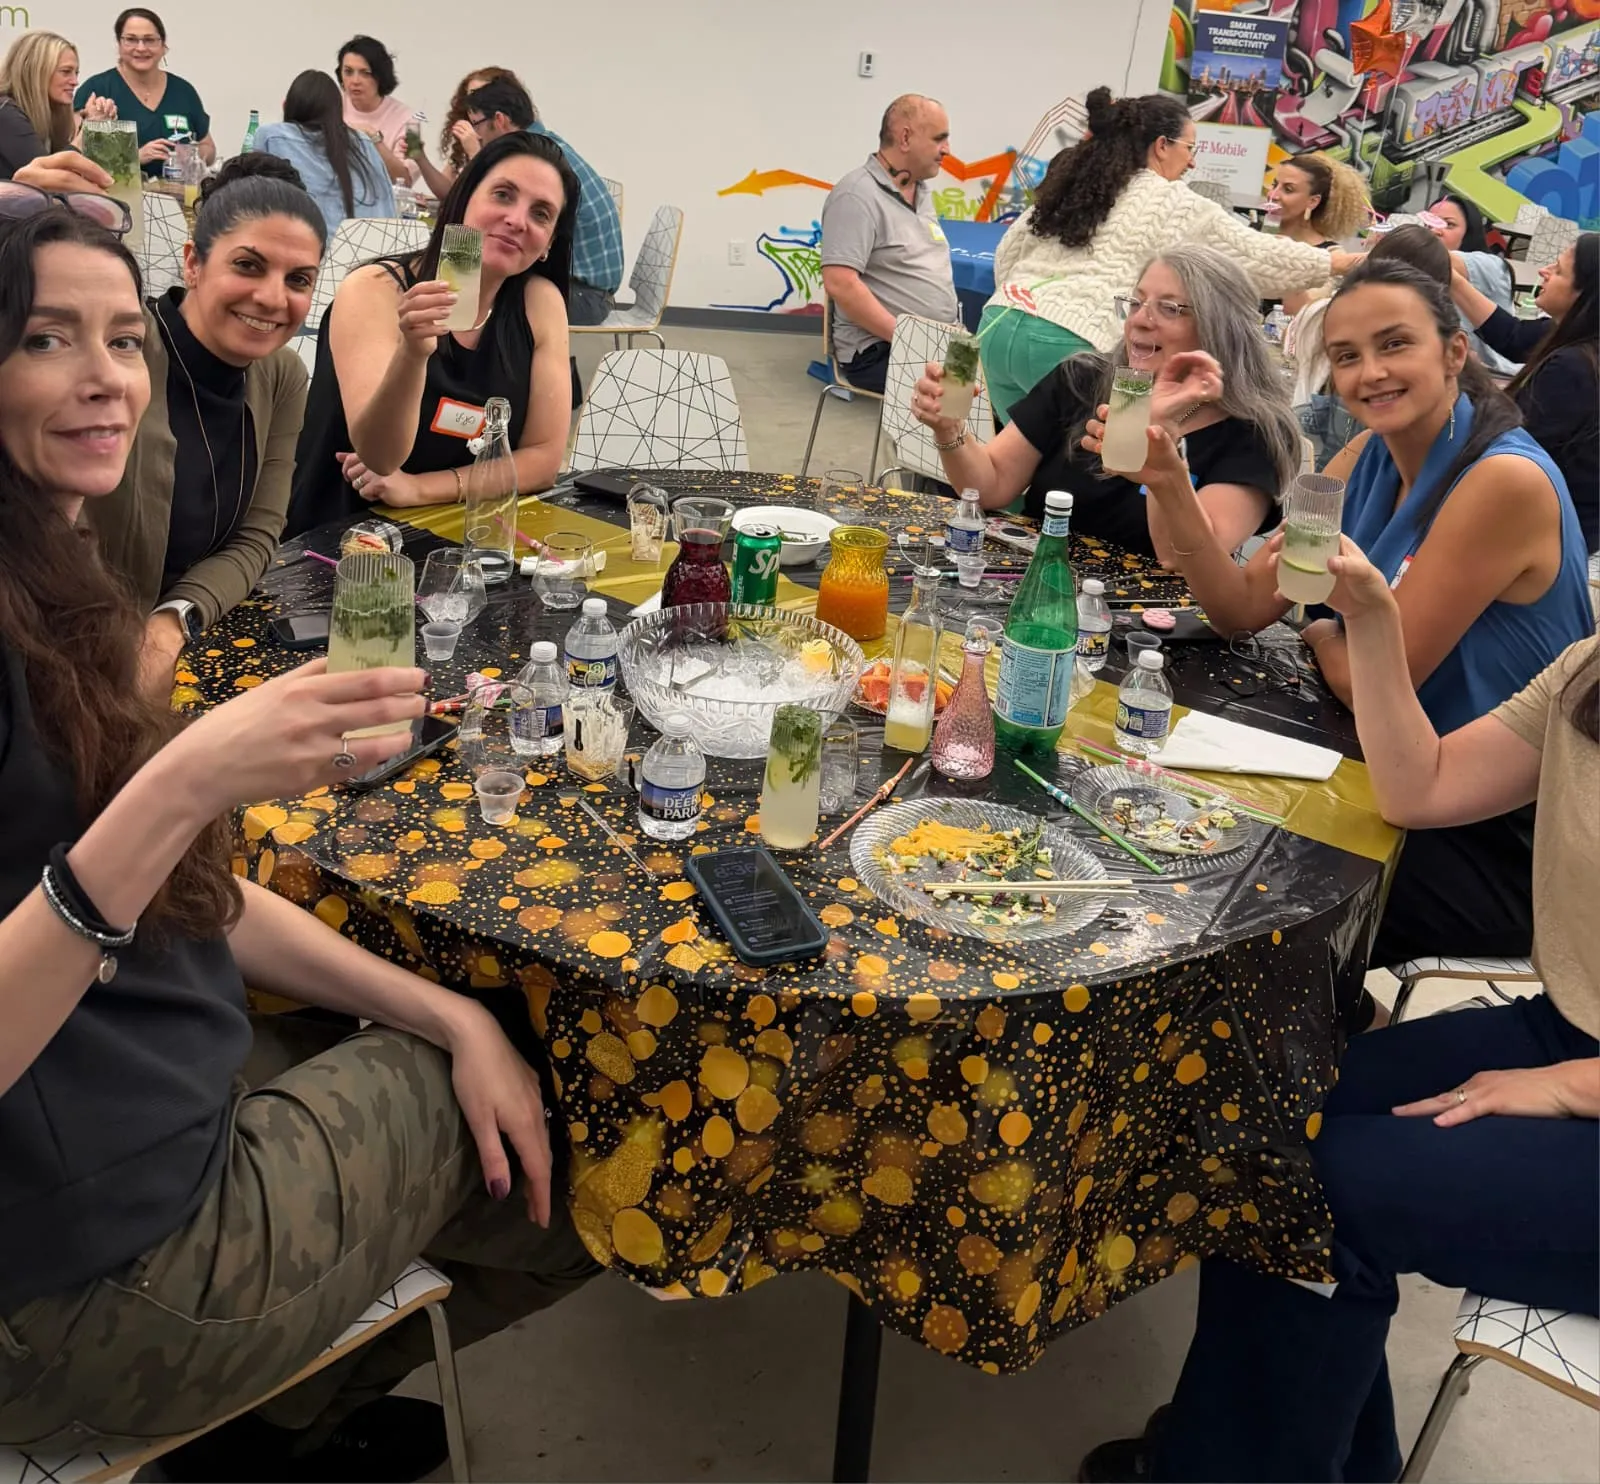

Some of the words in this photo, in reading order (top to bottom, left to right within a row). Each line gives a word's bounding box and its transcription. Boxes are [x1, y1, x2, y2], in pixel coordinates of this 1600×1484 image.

[1229, 21, 1258, 31] SMART
[1208, 27, 1277, 42] TRANSPORTATION
[1212, 36, 1270, 50] CONNECTIVITY
[1210, 141, 1248, 157] Mobile
[664, 794, 698, 808] DEER
[664, 805, 698, 819] PARK
